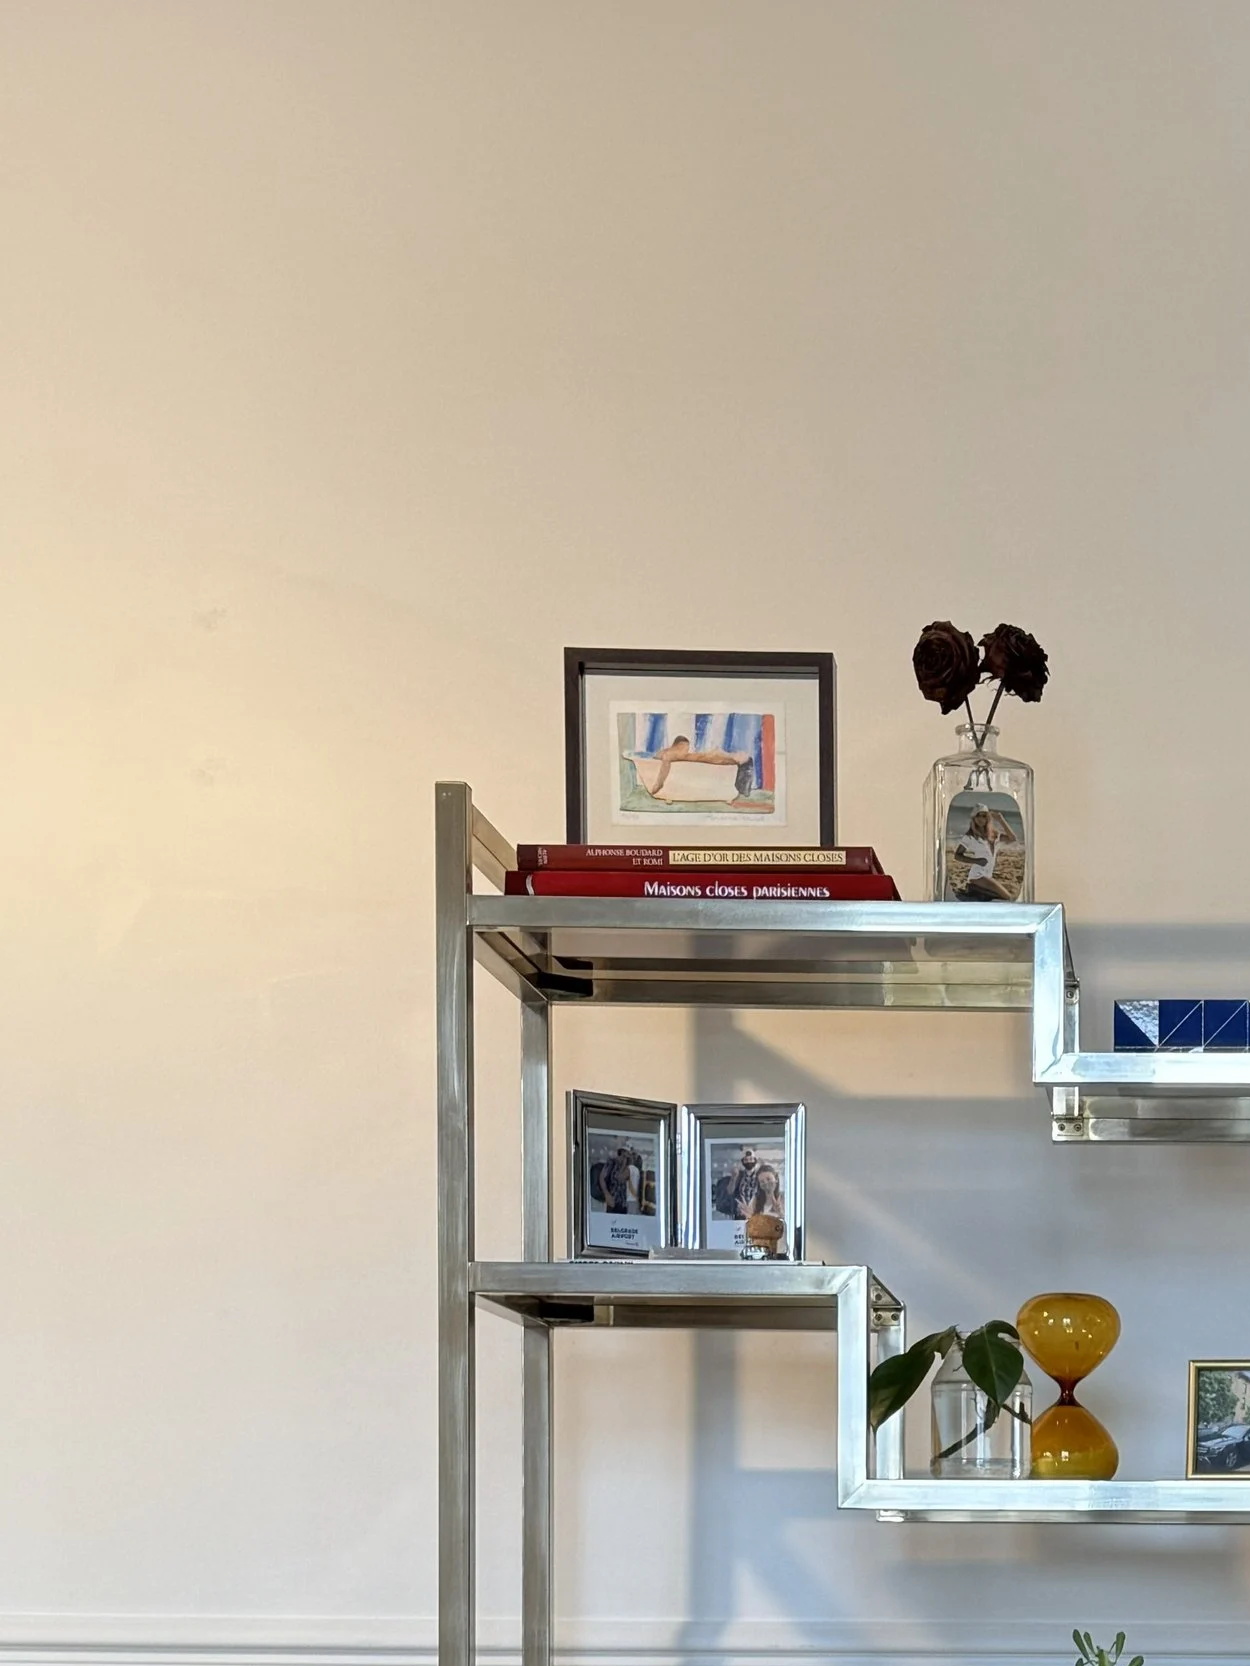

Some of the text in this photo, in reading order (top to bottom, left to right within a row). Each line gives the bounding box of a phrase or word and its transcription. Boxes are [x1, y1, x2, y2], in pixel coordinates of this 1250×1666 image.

[626, 849, 663, 858] BOUDARD
[703, 852, 729, 862] D'OR
[731, 852, 751, 862] DES
[803, 852, 844, 863] CLOSES
[643, 858, 663, 866] ROMI
